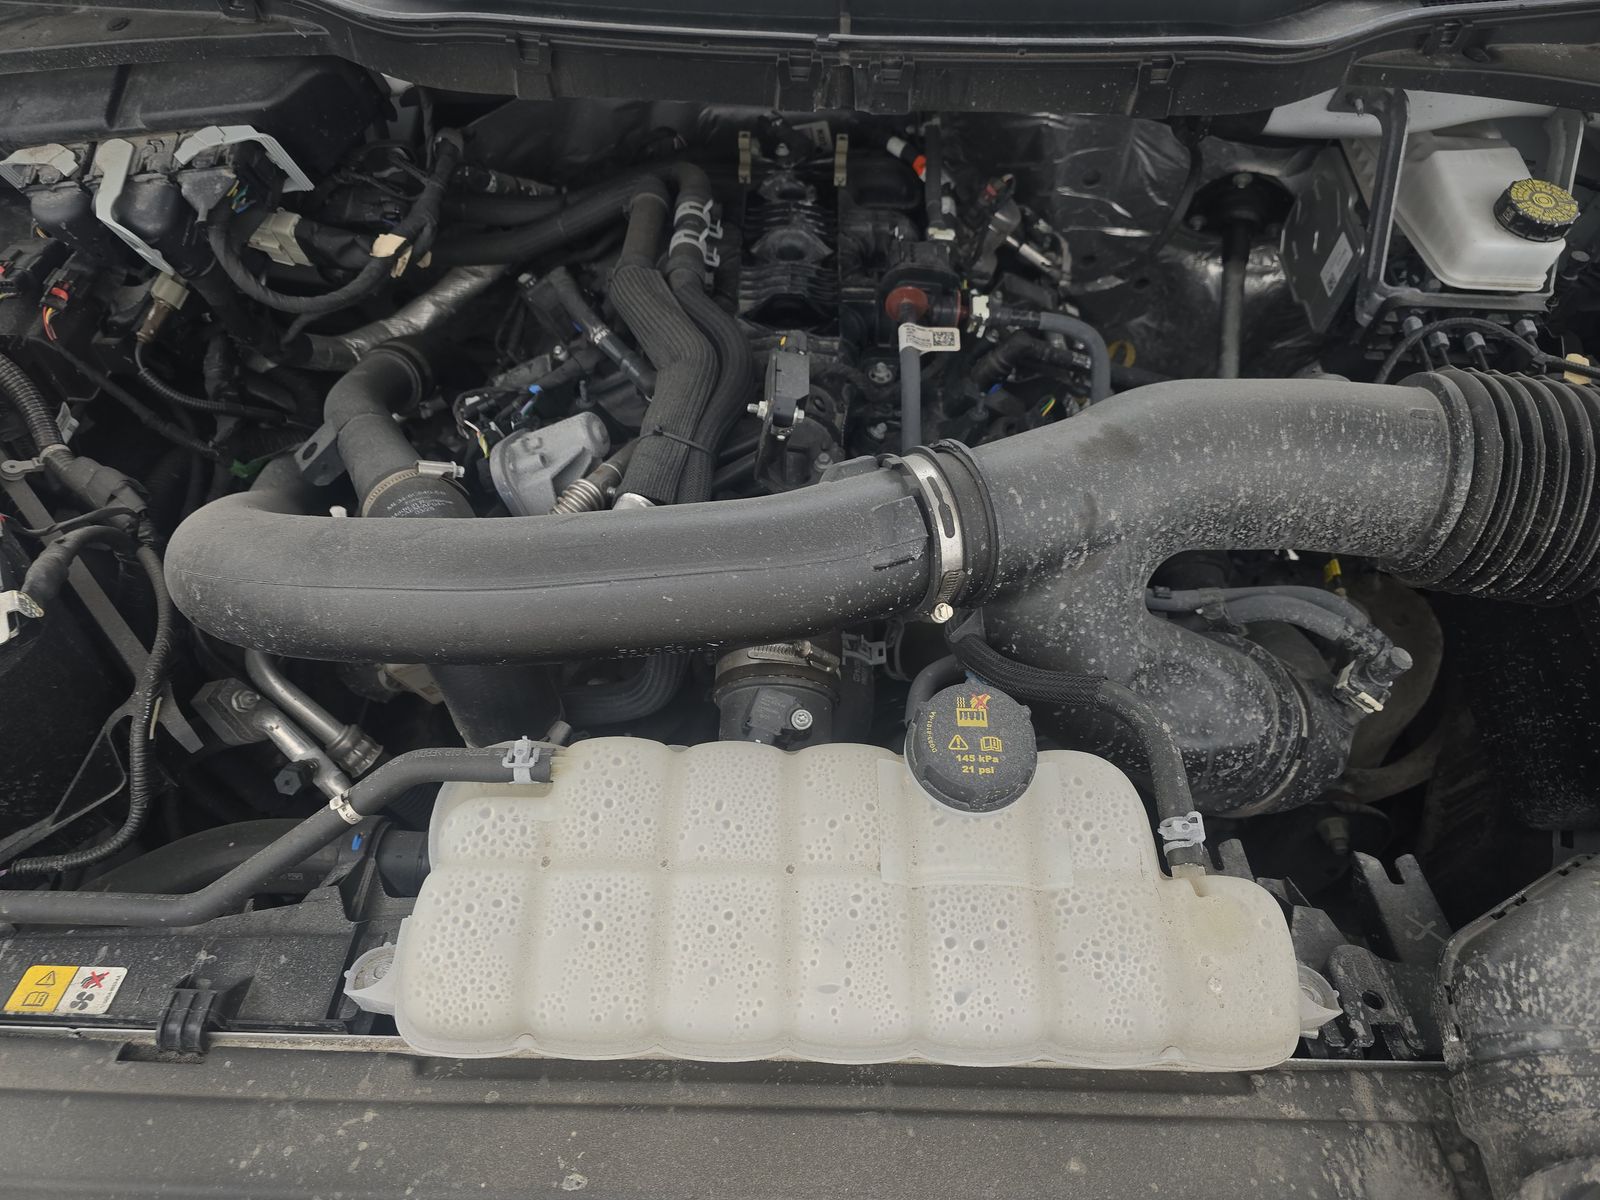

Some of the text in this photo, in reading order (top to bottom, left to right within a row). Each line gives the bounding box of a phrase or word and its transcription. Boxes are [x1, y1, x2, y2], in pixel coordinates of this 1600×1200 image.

[956, 754, 1000, 763] 145 kPa
[962, 765, 995, 775] 21 psi
